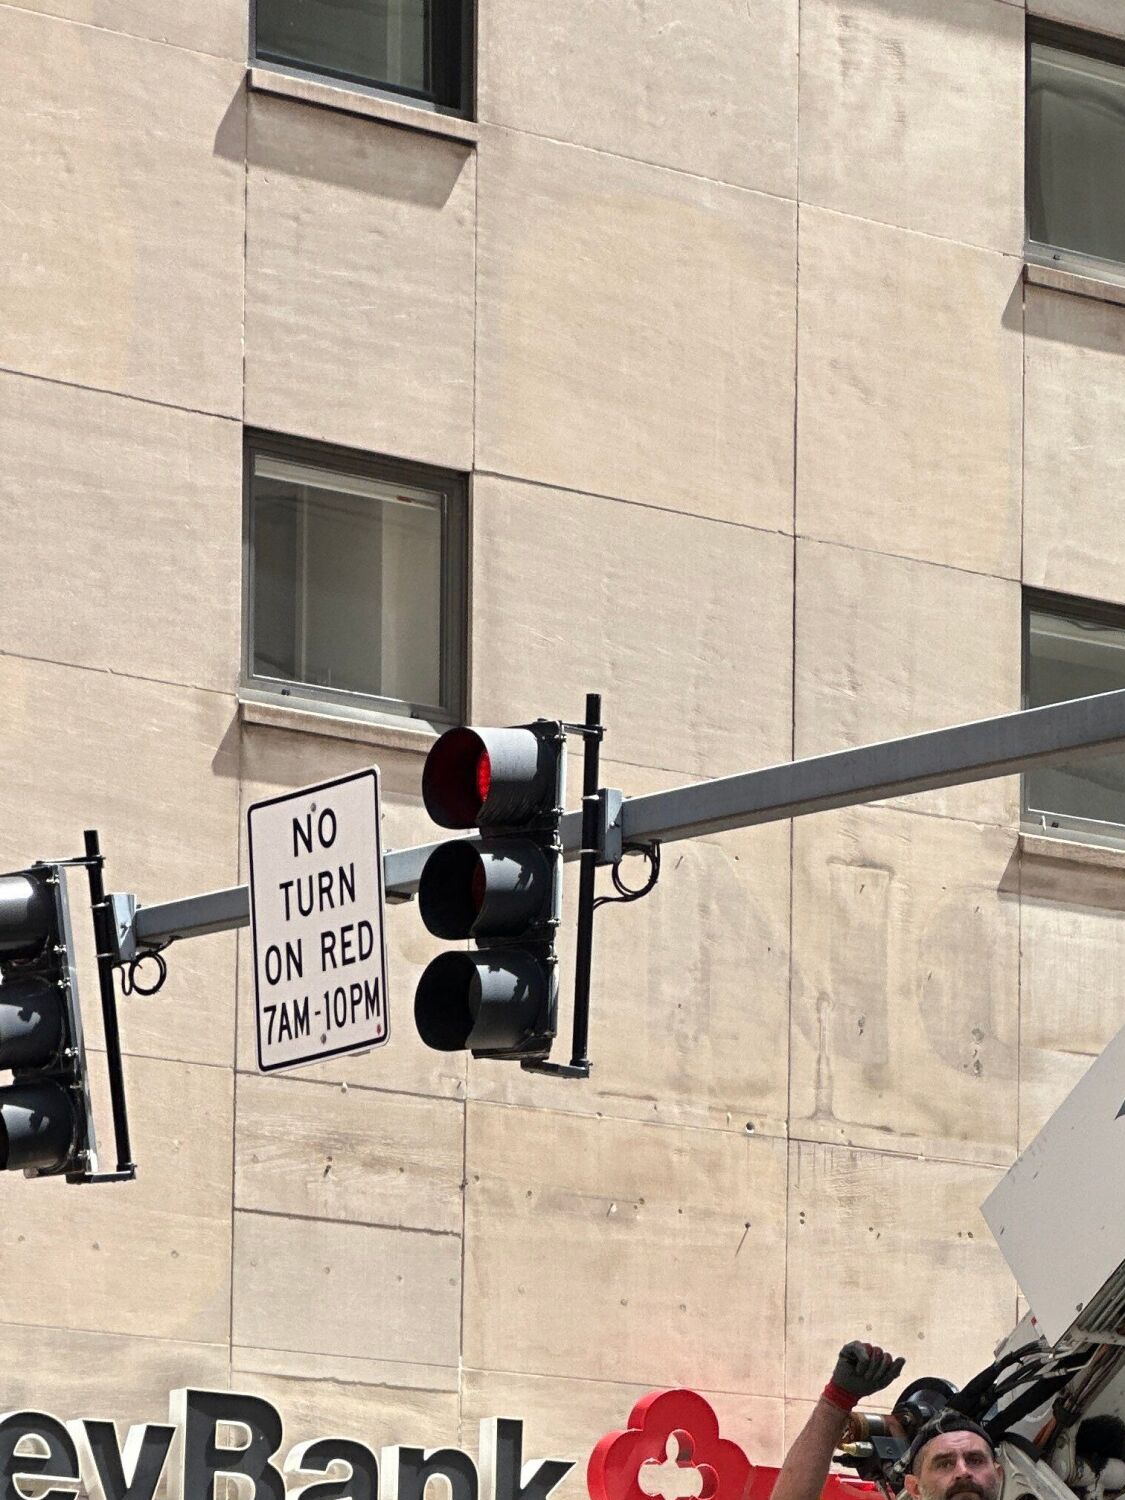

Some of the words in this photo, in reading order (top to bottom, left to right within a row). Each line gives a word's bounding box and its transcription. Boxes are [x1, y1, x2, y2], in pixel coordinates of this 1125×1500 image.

[292, 807, 337, 857] NO
[279, 863, 356, 921] TURN
[265, 938, 303, 986] ON
[320, 919, 374, 972] RED
[263, 976, 381, 1045] 7AM-10PM
